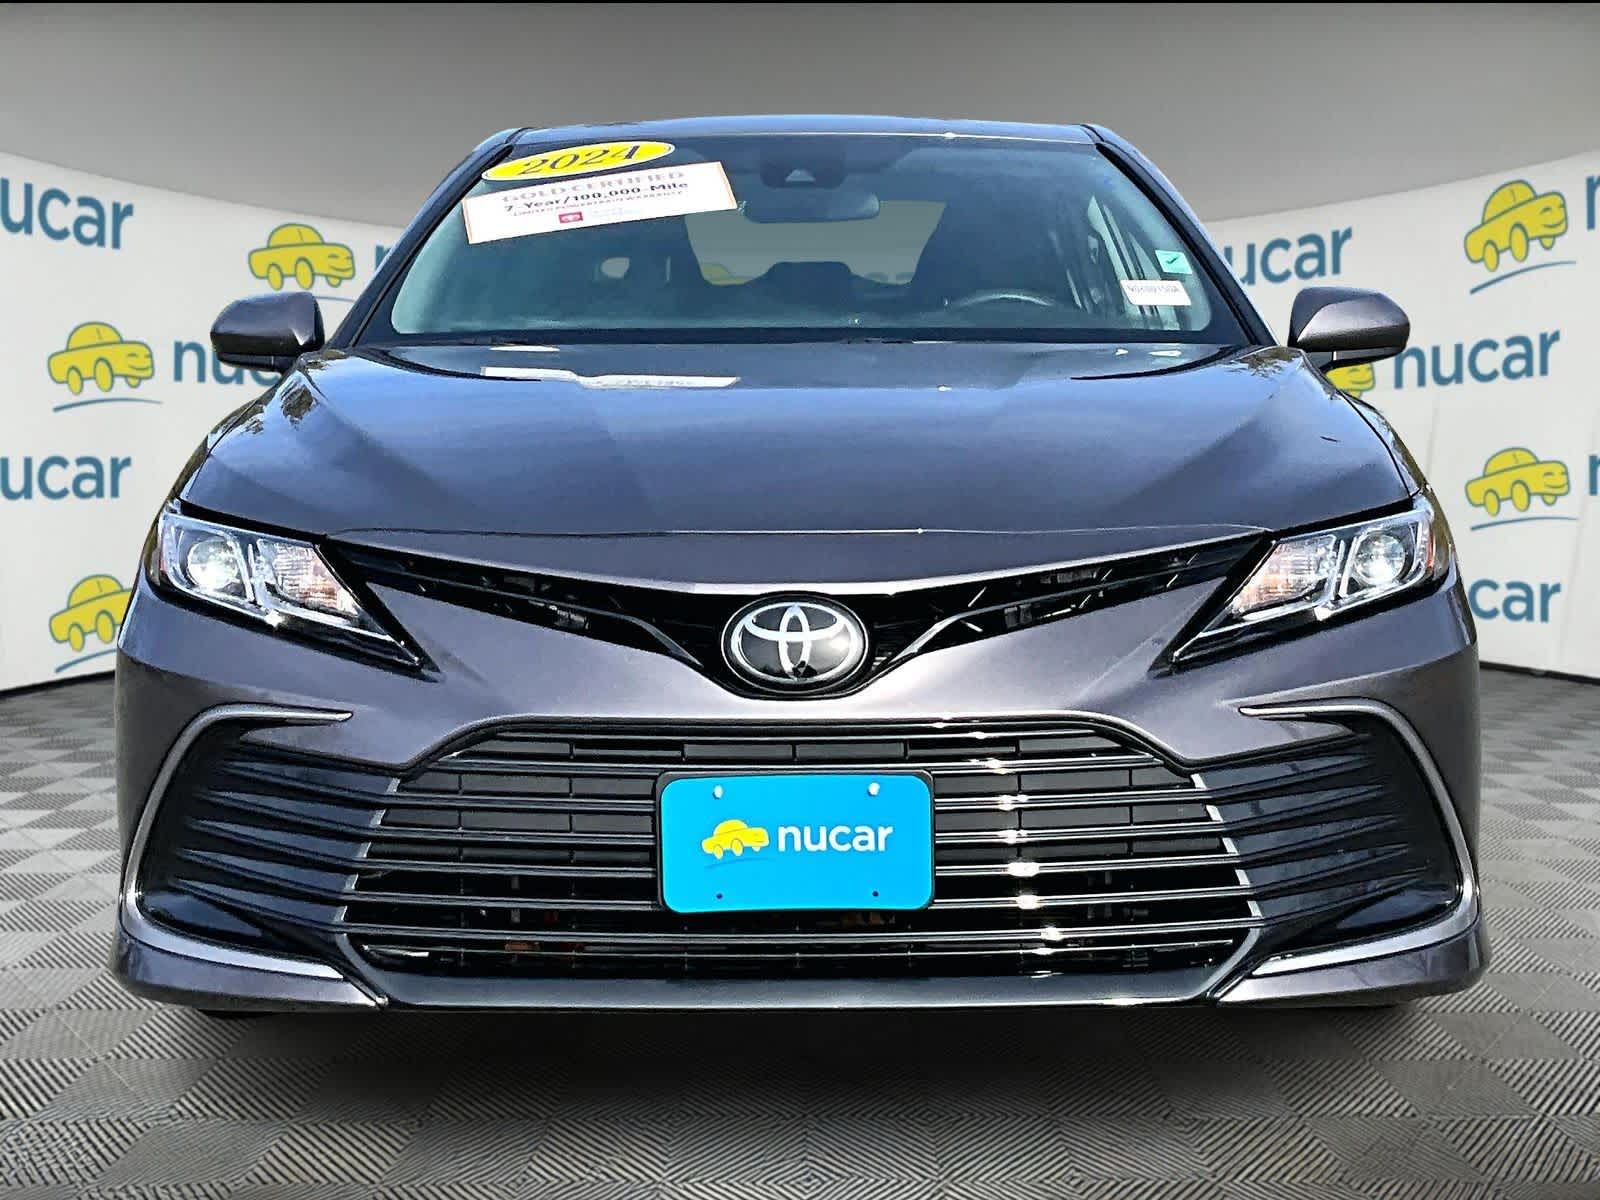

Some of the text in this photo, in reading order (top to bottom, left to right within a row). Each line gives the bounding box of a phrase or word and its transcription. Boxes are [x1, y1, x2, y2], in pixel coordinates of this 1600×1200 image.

[519, 146, 640, 175] 2024
[0, 178, 134, 249] ucar
[1223, 226, 1353, 285] ucar
[1394, 330, 1560, 389] nucar
[0, 456, 131, 500] ucar
[1469, 579, 1561, 623] car
[777, 824, 894, 852] nucar
